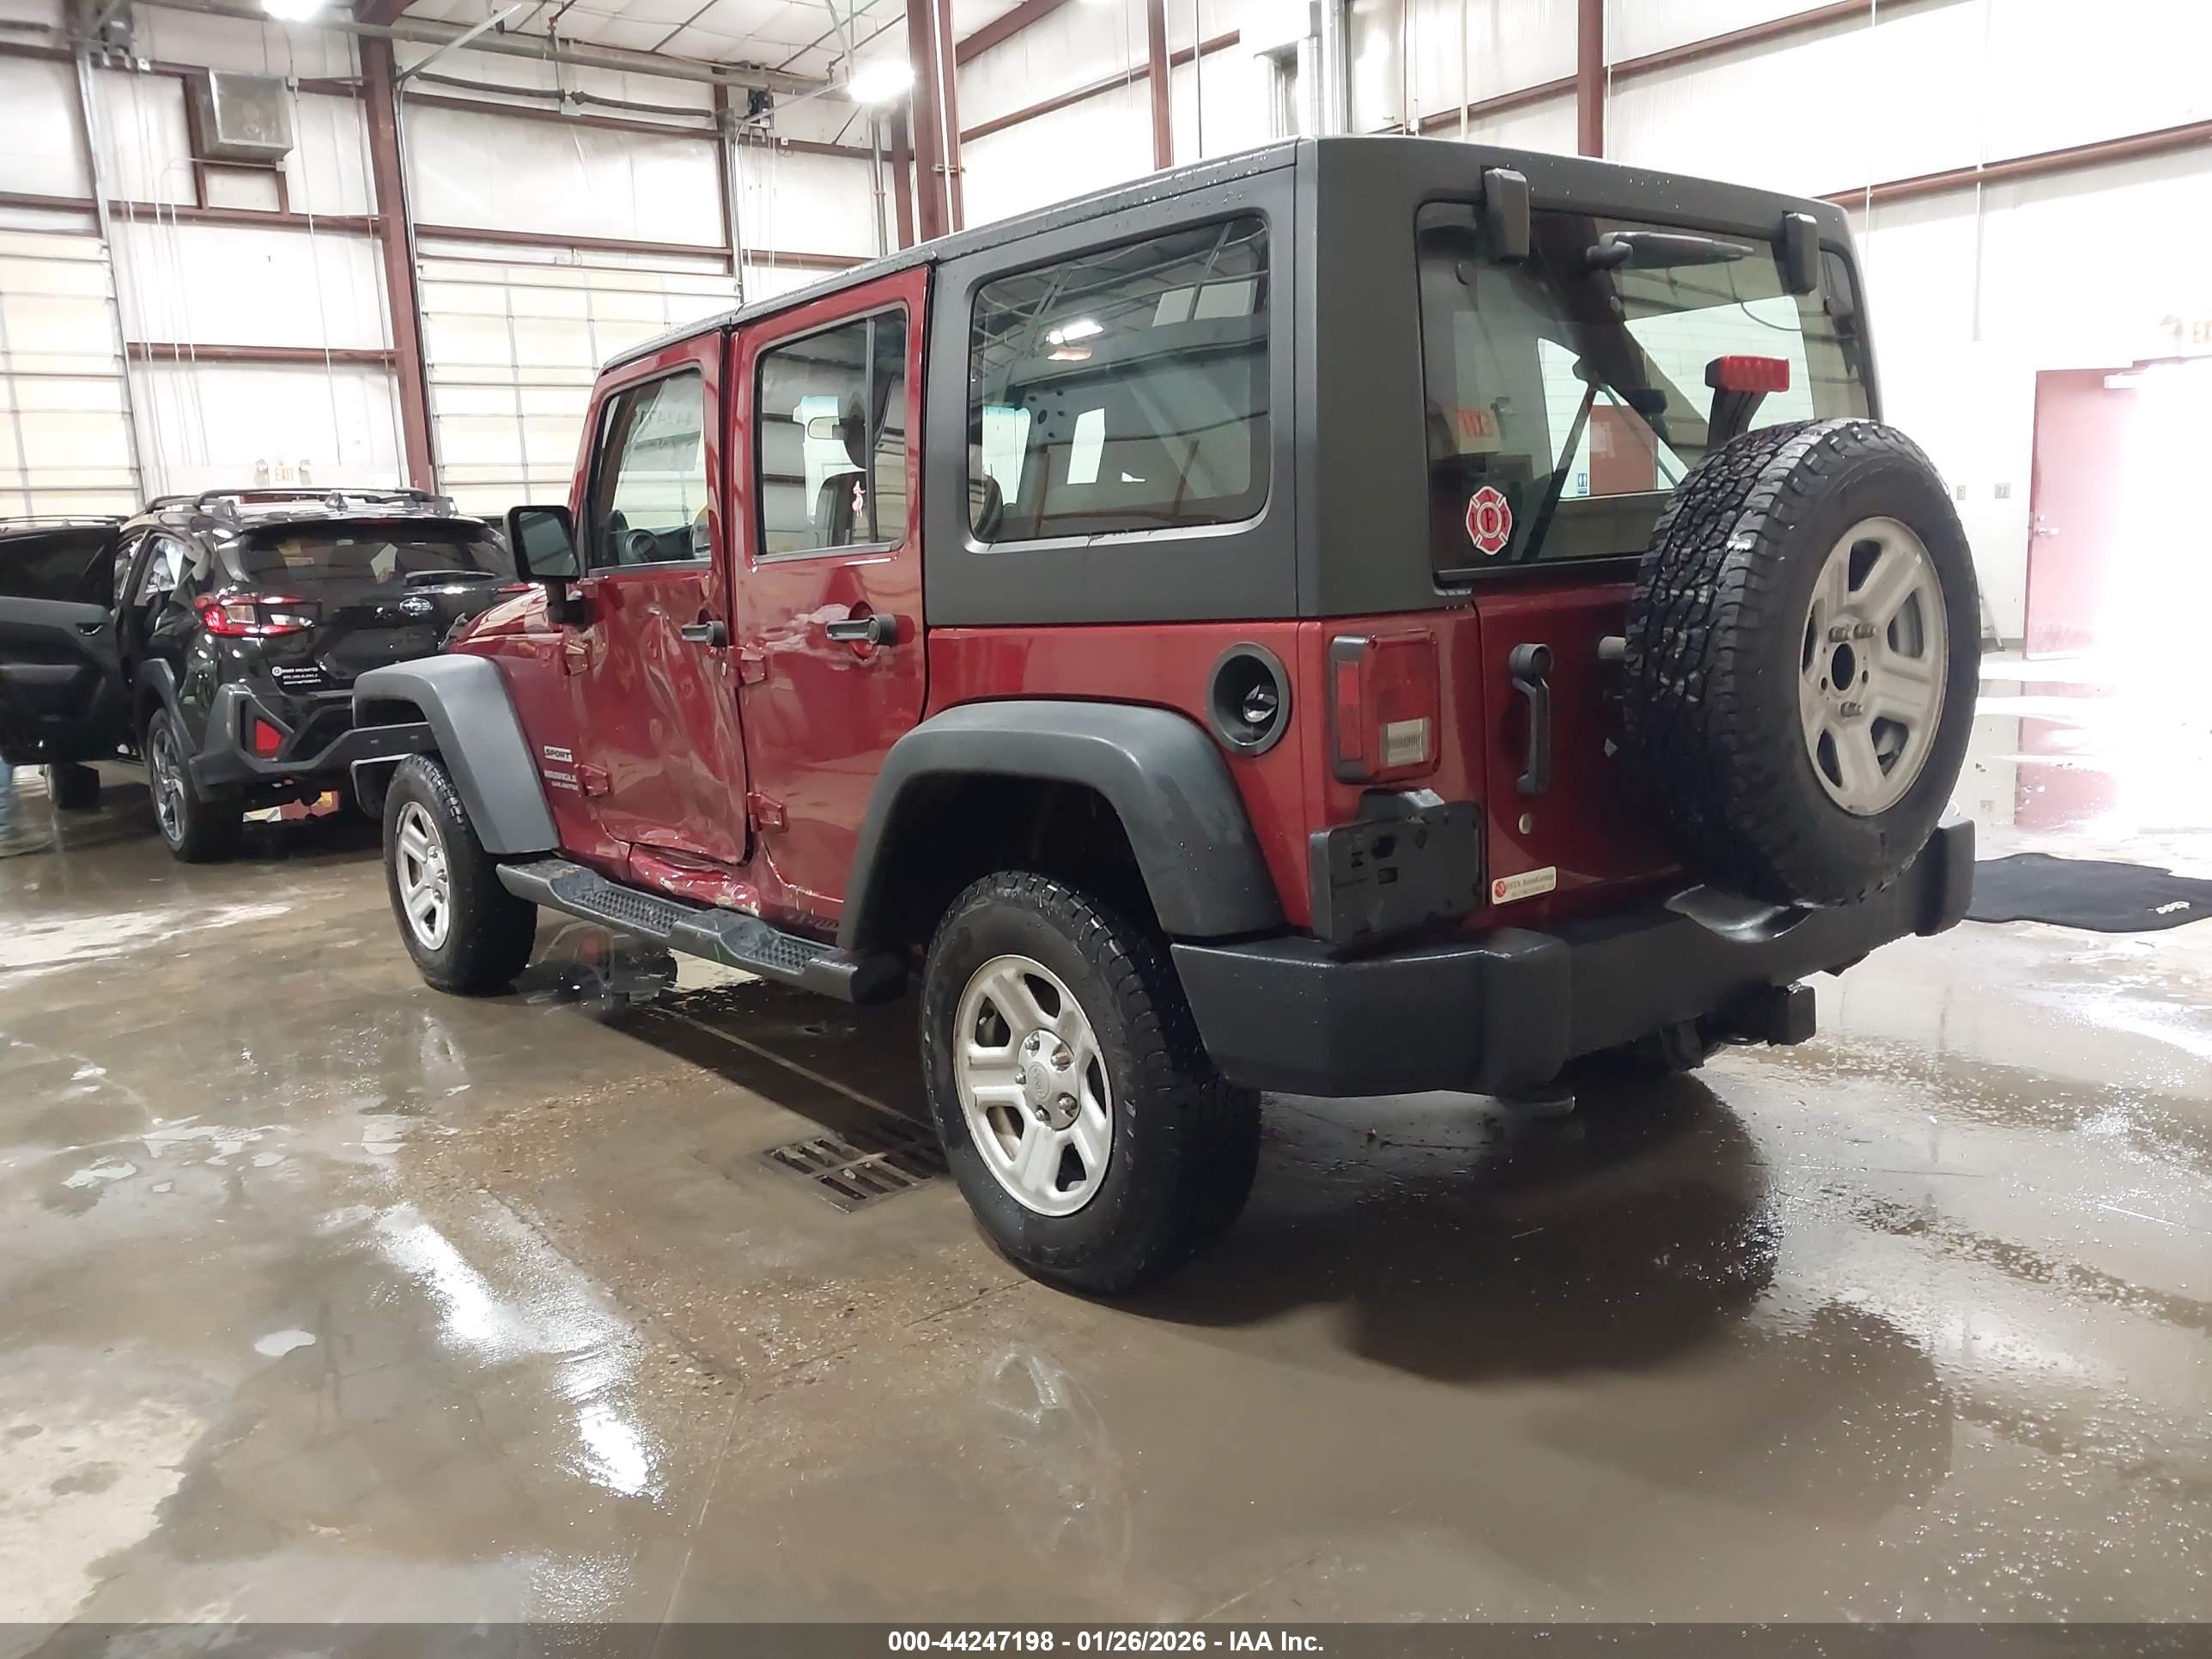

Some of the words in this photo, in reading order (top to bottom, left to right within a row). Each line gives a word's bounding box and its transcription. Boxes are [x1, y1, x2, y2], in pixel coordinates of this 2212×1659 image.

[2193, 320, 2212, 343] EX
[274, 467, 295, 481] EXIT
[545, 748, 569, 760] SPORT
